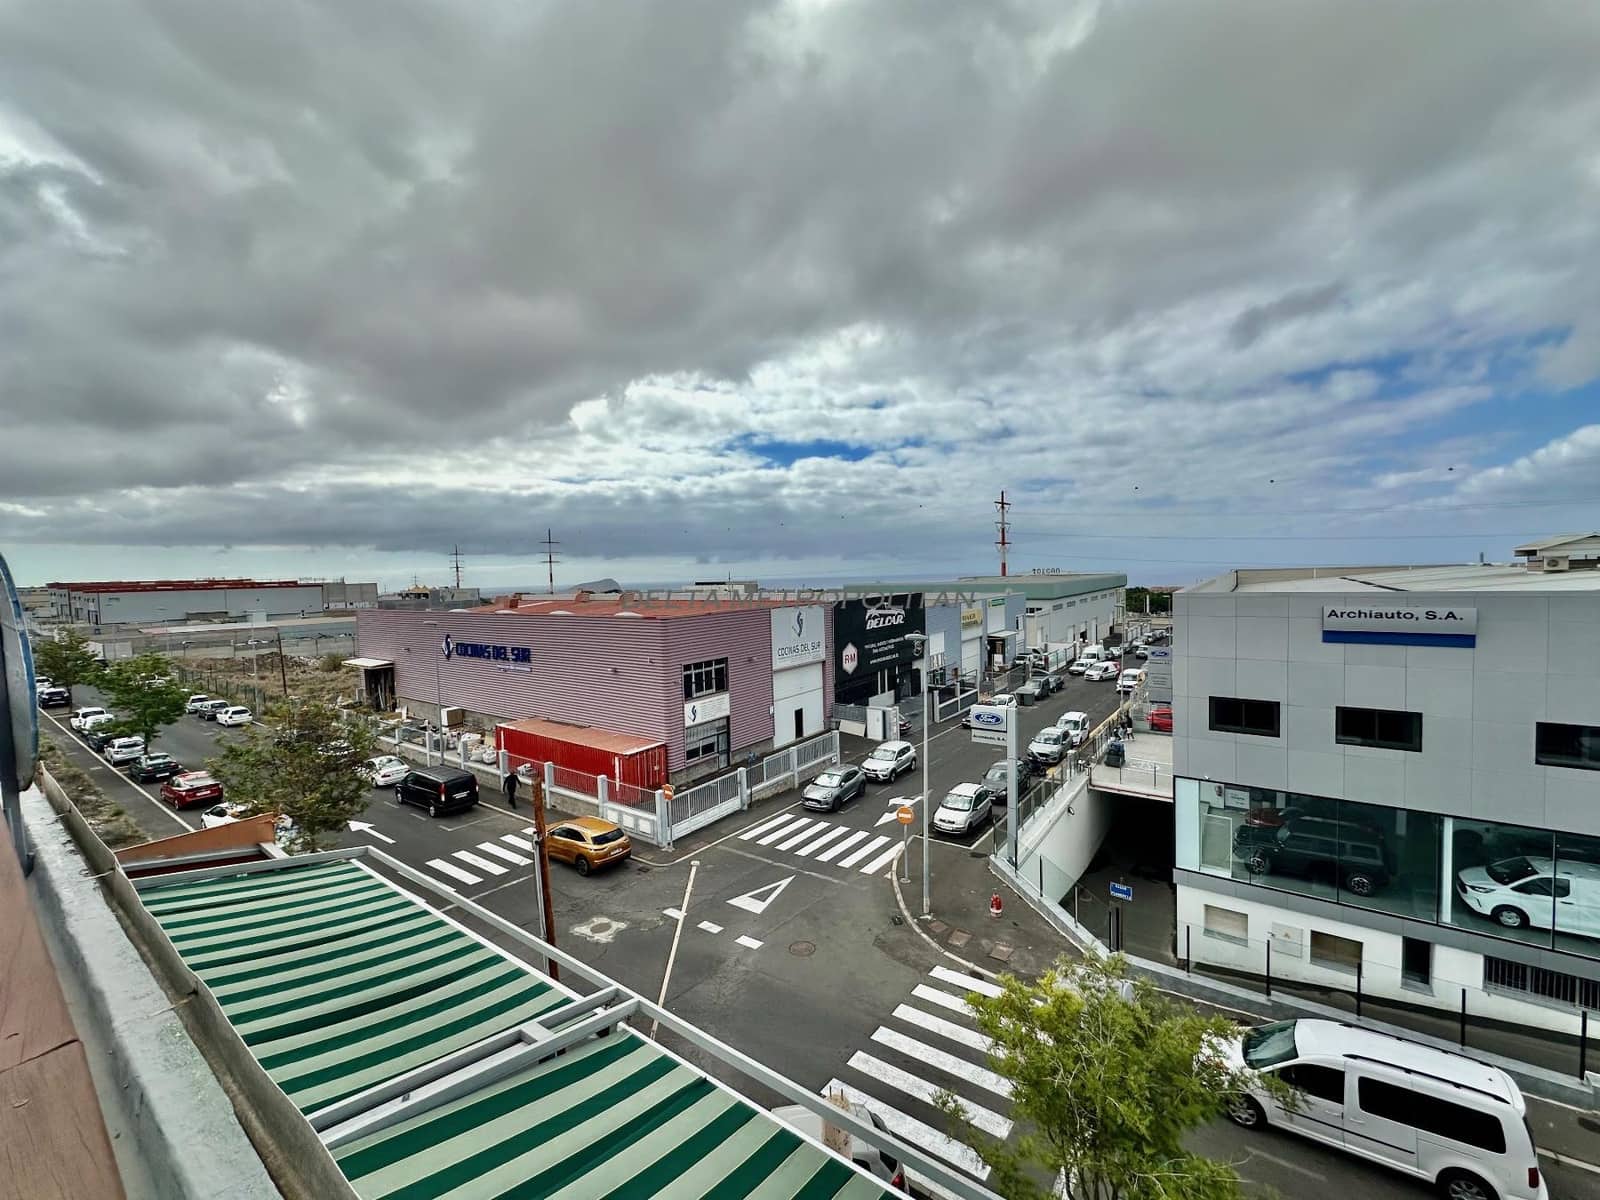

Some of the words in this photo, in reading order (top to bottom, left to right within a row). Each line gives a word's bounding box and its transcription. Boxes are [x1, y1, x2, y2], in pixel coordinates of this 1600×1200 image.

[1327, 609, 1419, 621] Archiauto,
[1424, 610, 1464, 621] S.A.
[865, 614, 905, 630] DELCAR
[844, 653, 856, 664] RM
[977, 713, 1000, 723] Ford
